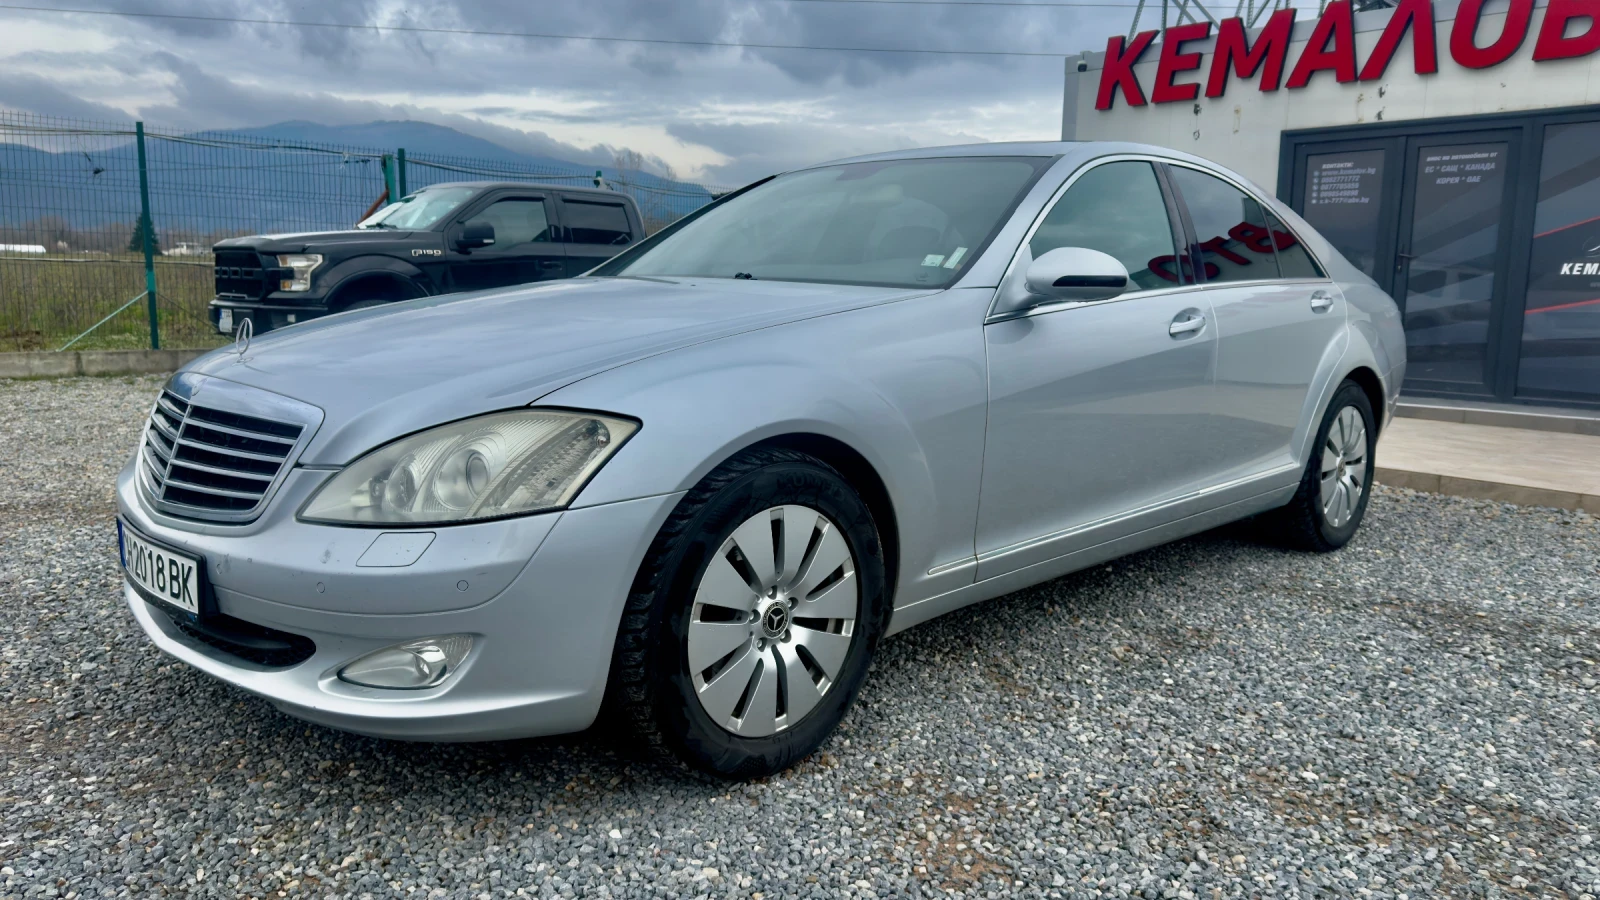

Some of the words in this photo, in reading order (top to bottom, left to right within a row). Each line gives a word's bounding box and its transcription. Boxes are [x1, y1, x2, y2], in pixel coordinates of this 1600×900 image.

[1441, 164, 1459, 173] САЩ
[1464, 162, 1496, 171] КАНАДА
[1435, 176, 1460, 185] КОРЕЯ
[1560, 262, 1600, 276] КЕМ
